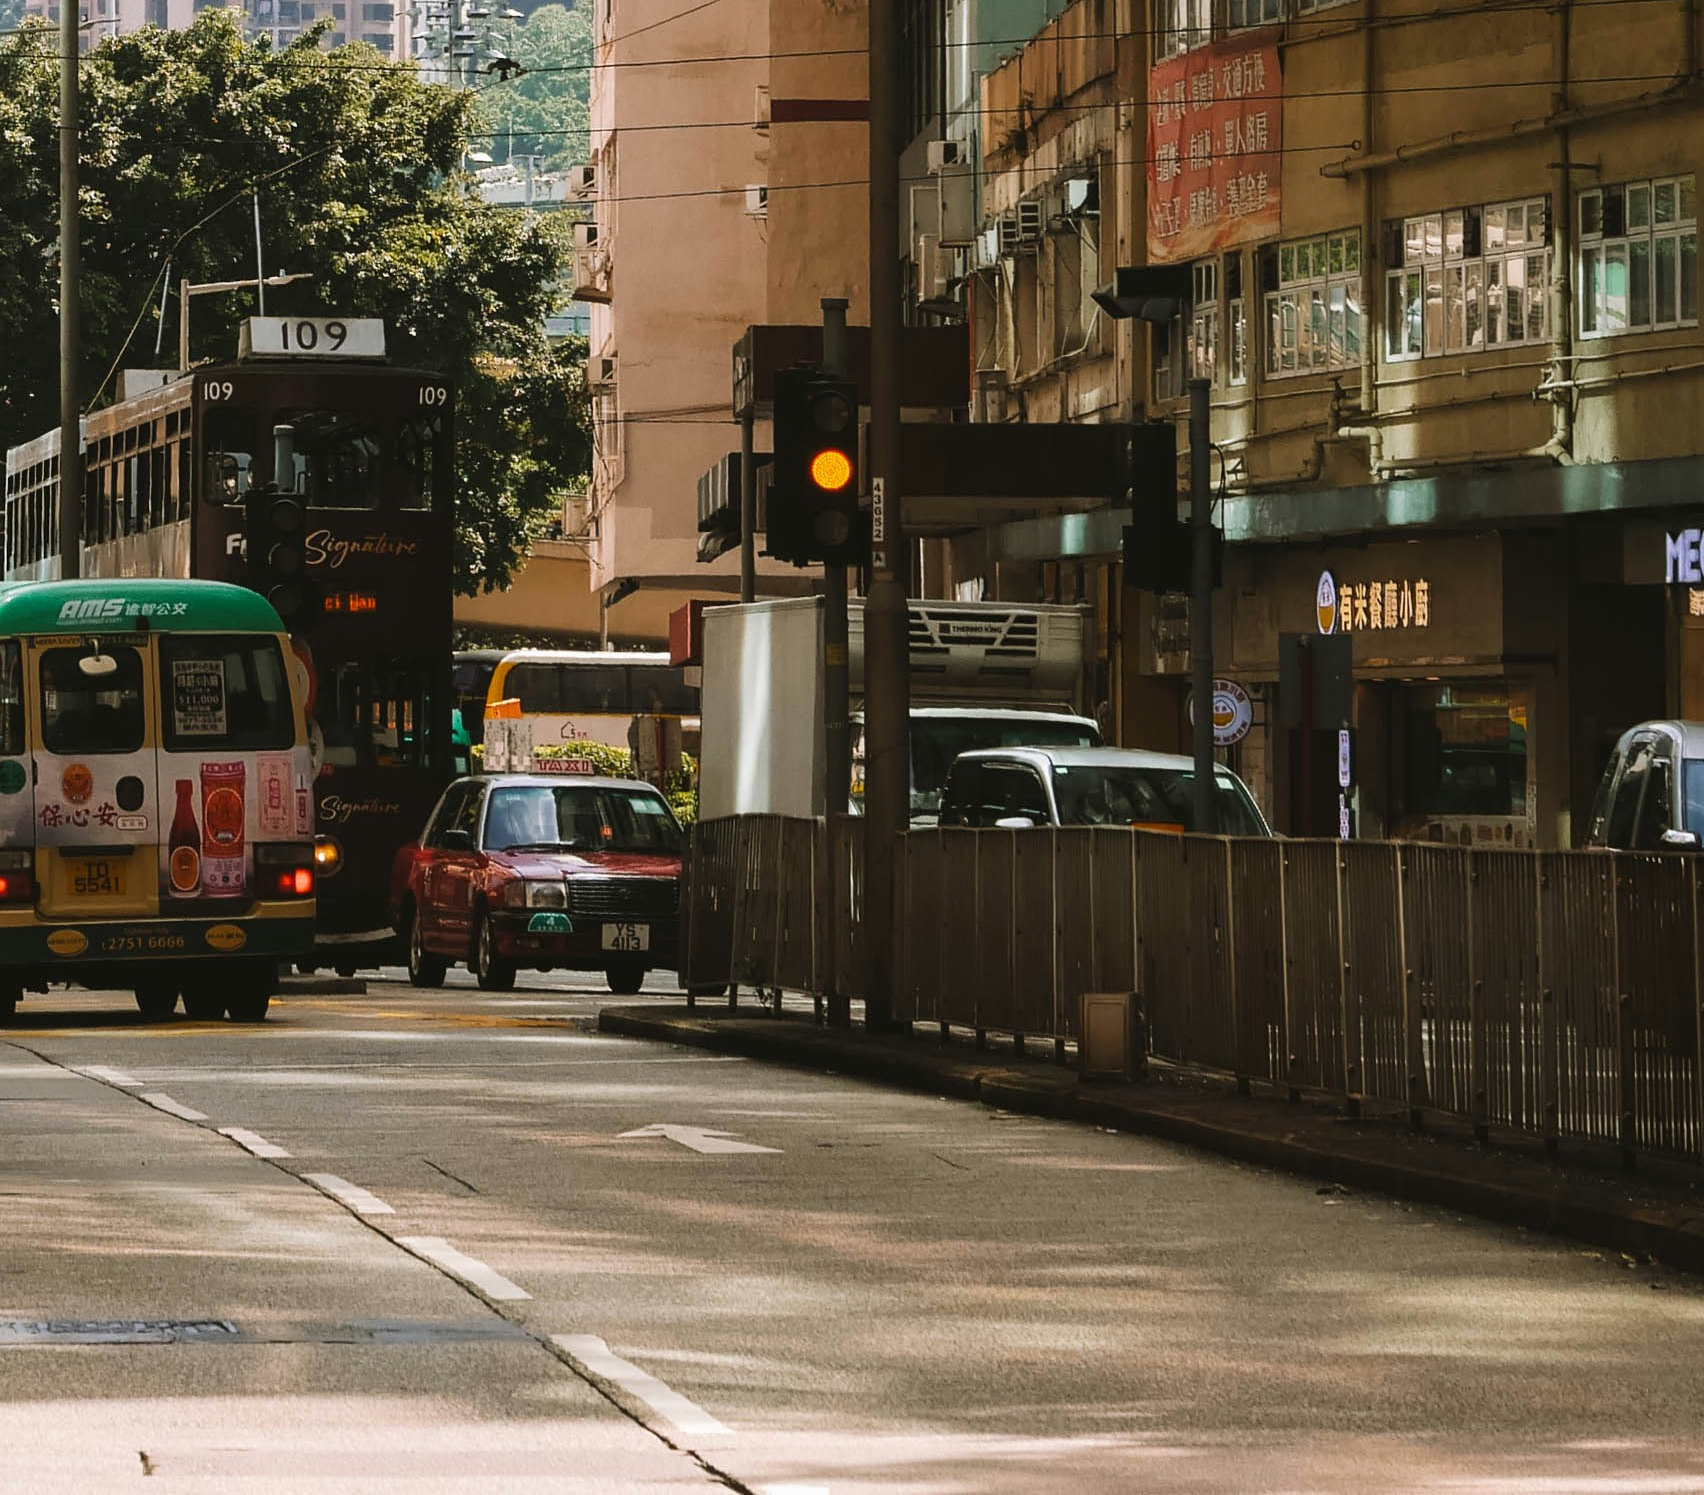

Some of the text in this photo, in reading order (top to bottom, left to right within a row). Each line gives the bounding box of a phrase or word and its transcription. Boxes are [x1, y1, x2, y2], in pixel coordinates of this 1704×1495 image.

[281, 320, 348, 351] 109
[203, 382, 233, 401] 109
[419, 386, 447, 405] 109
[304, 529, 418, 569] Signature
[59, 598, 126, 618] AMS
[951, 625, 1002, 633] THERMO KING
[536, 759, 590, 772] TAXI
[39, 801, 118, 827] 保心安
[615, 923, 636, 937] YS
[108, 936, 143, 950] 2751
[611, 936, 641, 951] 4113
